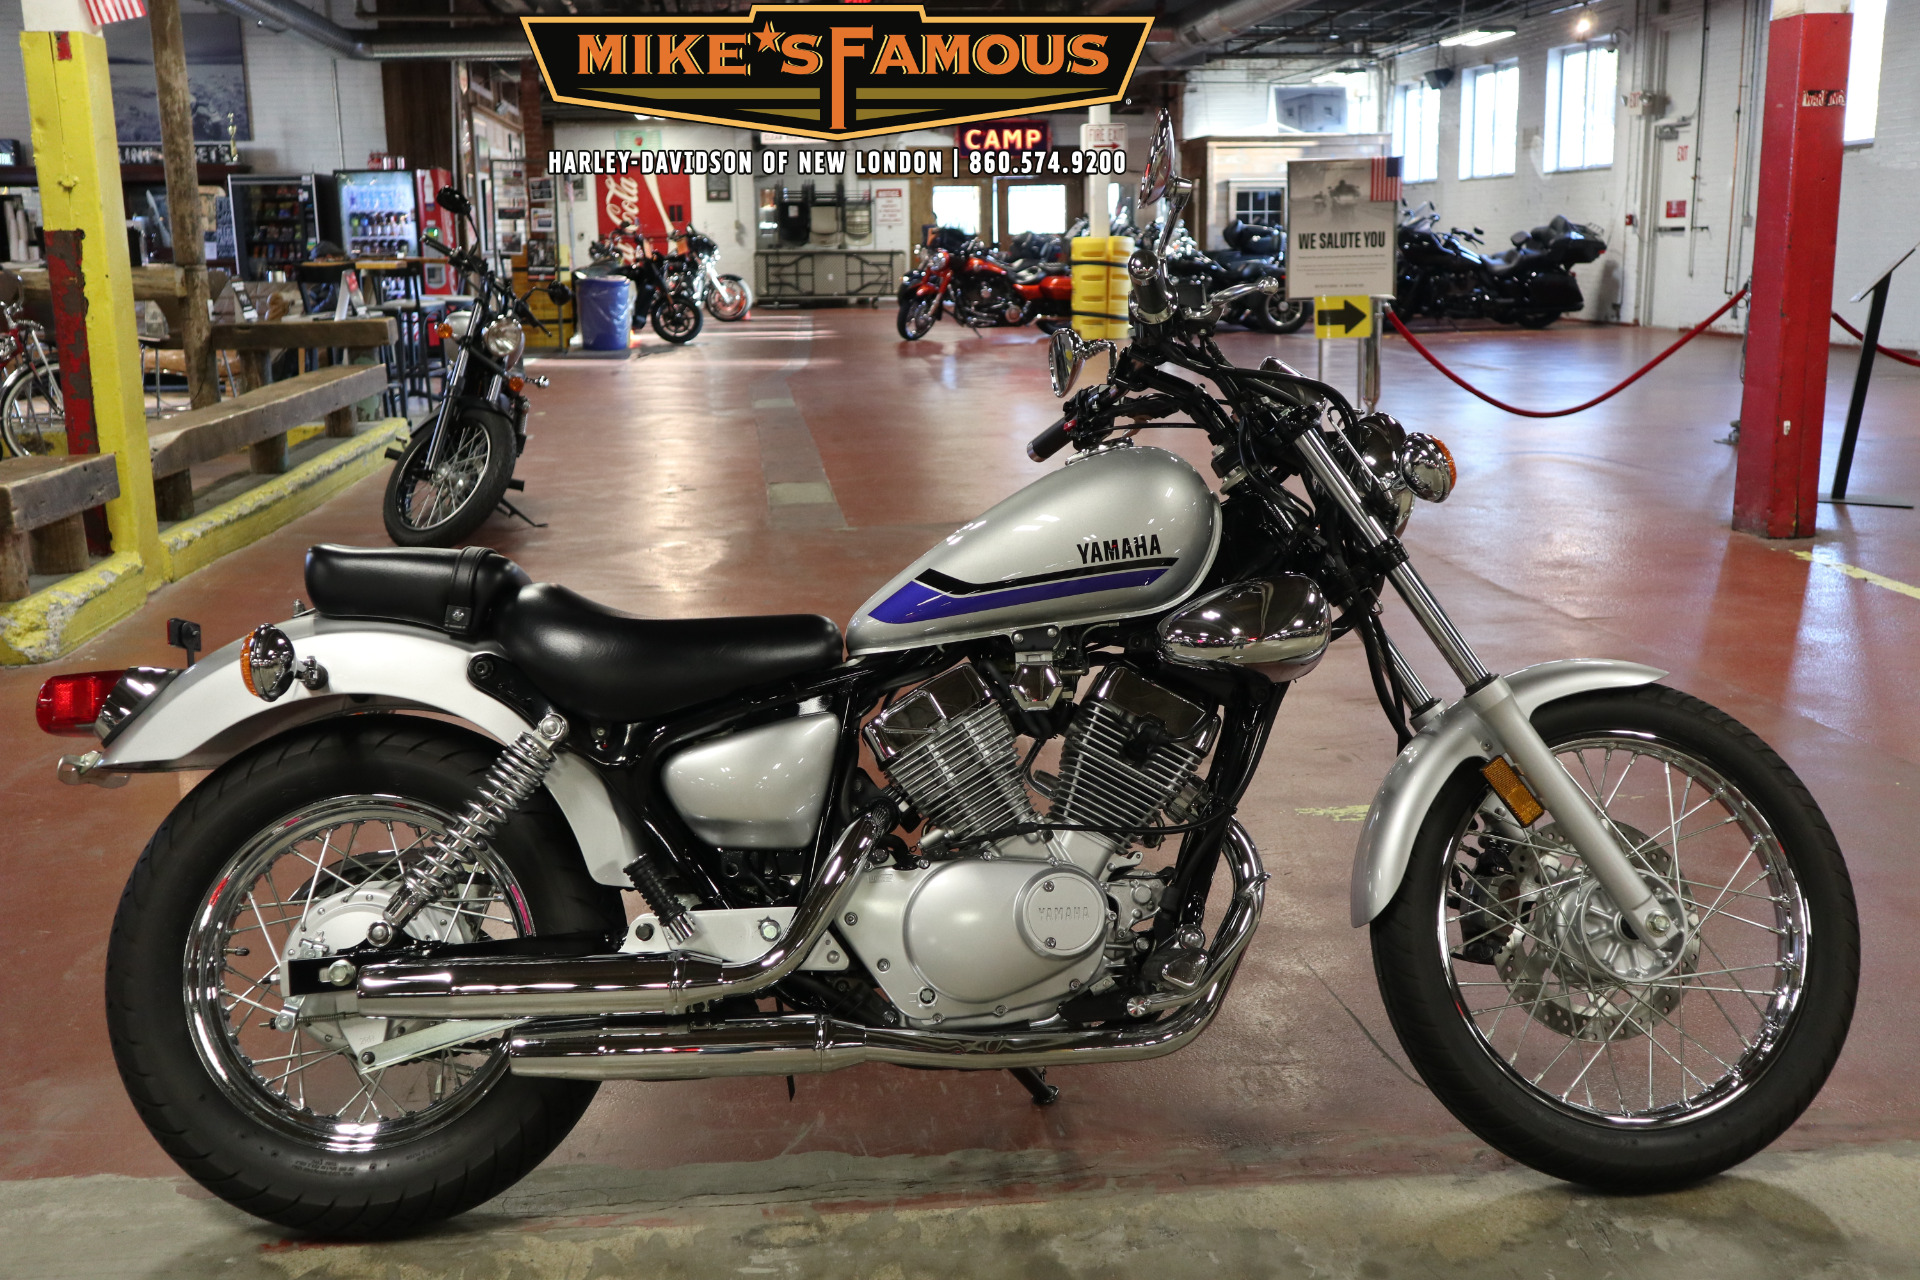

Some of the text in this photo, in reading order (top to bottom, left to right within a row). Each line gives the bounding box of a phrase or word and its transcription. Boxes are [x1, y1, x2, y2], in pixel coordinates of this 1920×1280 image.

[1804, 89, 1845, 106] WARING
[964, 128, 1043, 150] CAMP
[1089, 128, 1124, 141] FIRE EXIT
[1677, 145, 1688, 161] EXIT
[1298, 230, 1386, 249] WE SALUTE YOU
[1076, 533, 1162, 565] YAMAHA
[1038, 906, 1090, 921] YAMAHA
